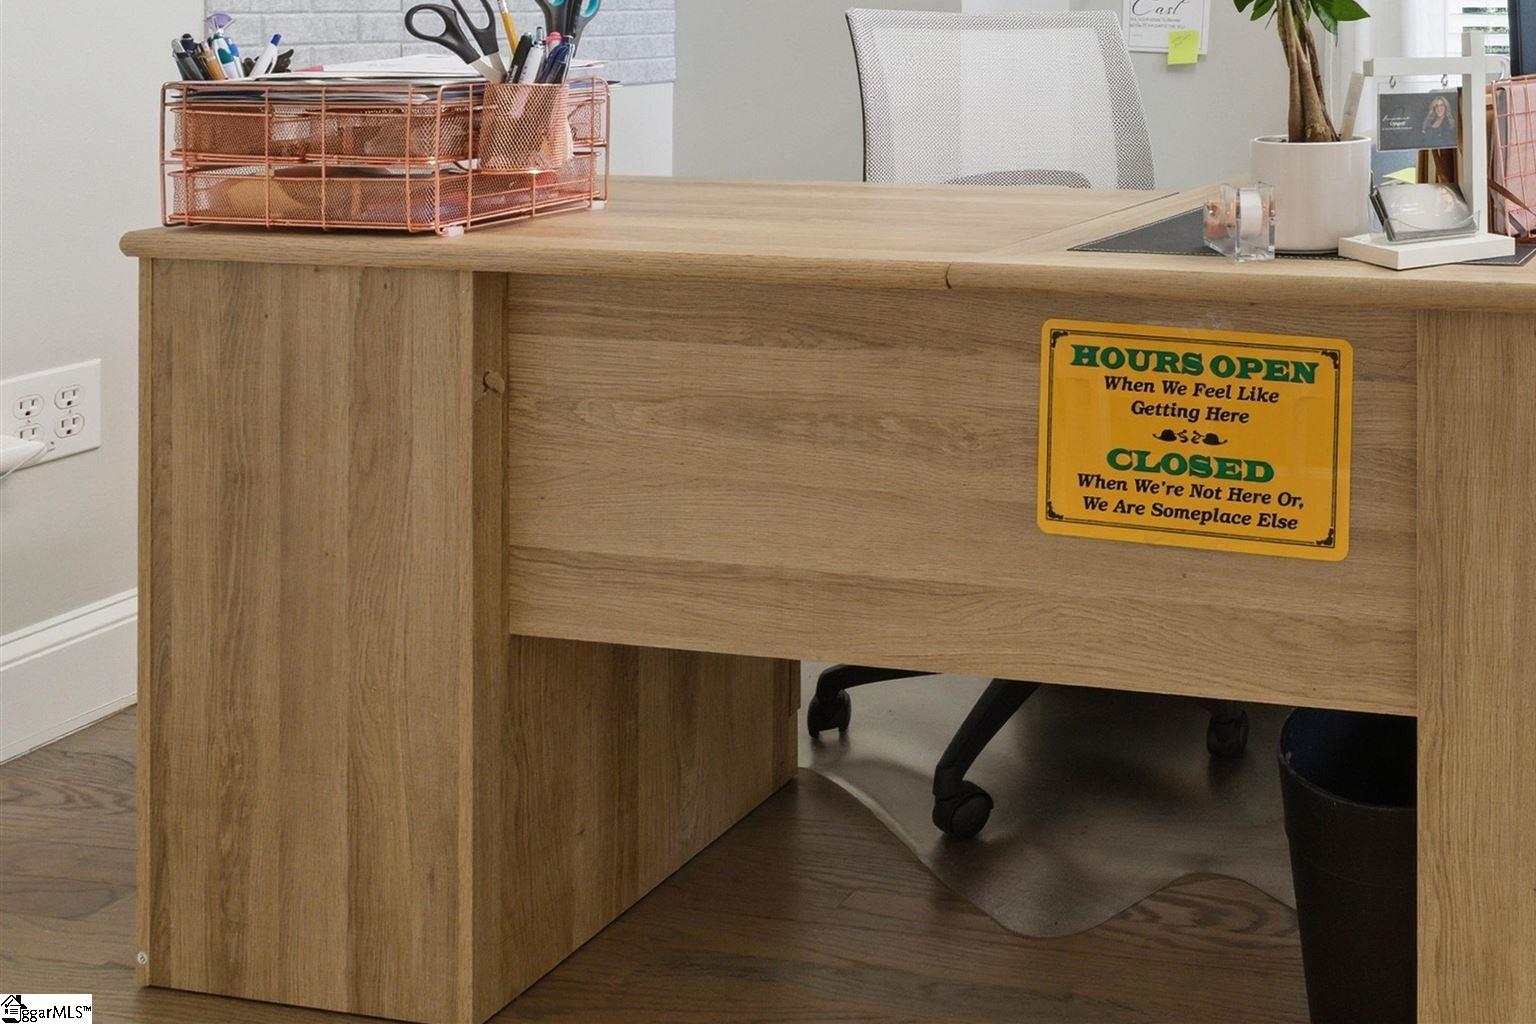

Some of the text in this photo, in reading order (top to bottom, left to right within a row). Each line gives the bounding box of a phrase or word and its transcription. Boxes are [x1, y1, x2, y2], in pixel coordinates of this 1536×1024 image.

[1070, 344, 1320, 385] HOURS OPEN
[1104, 375, 1280, 404] When We Feel Like
[1130, 400, 1250, 424] Getting Here
[1106, 447, 1275, 484] CLOSED
[1077, 473, 1305, 509] When We're Not Here Or,
[1082, 495, 1299, 530] We Are Someplace Else
